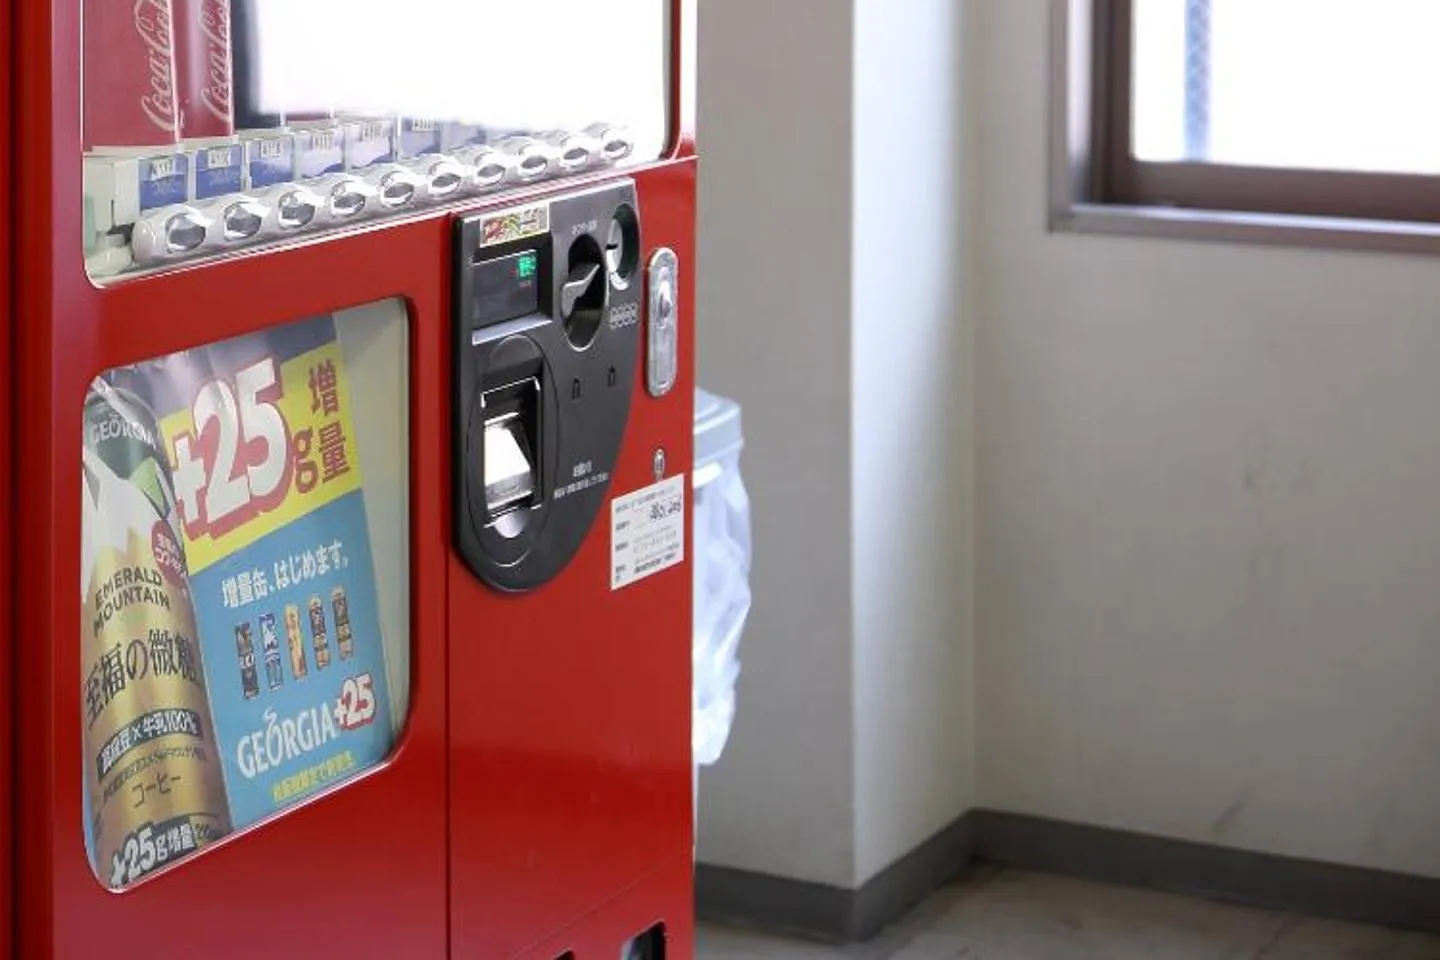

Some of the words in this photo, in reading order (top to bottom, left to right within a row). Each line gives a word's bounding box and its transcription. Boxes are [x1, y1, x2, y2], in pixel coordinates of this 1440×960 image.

[308, 358, 351, 484] 増量
[95, 566, 162, 611] EMERALD
[221, 539, 349, 609] 増量缶、はじめます。
[93, 587, 170, 639] MOUNTAIN
[236, 701, 338, 780] GEORGIA
[131, 771, 182, 809] コーヒー
